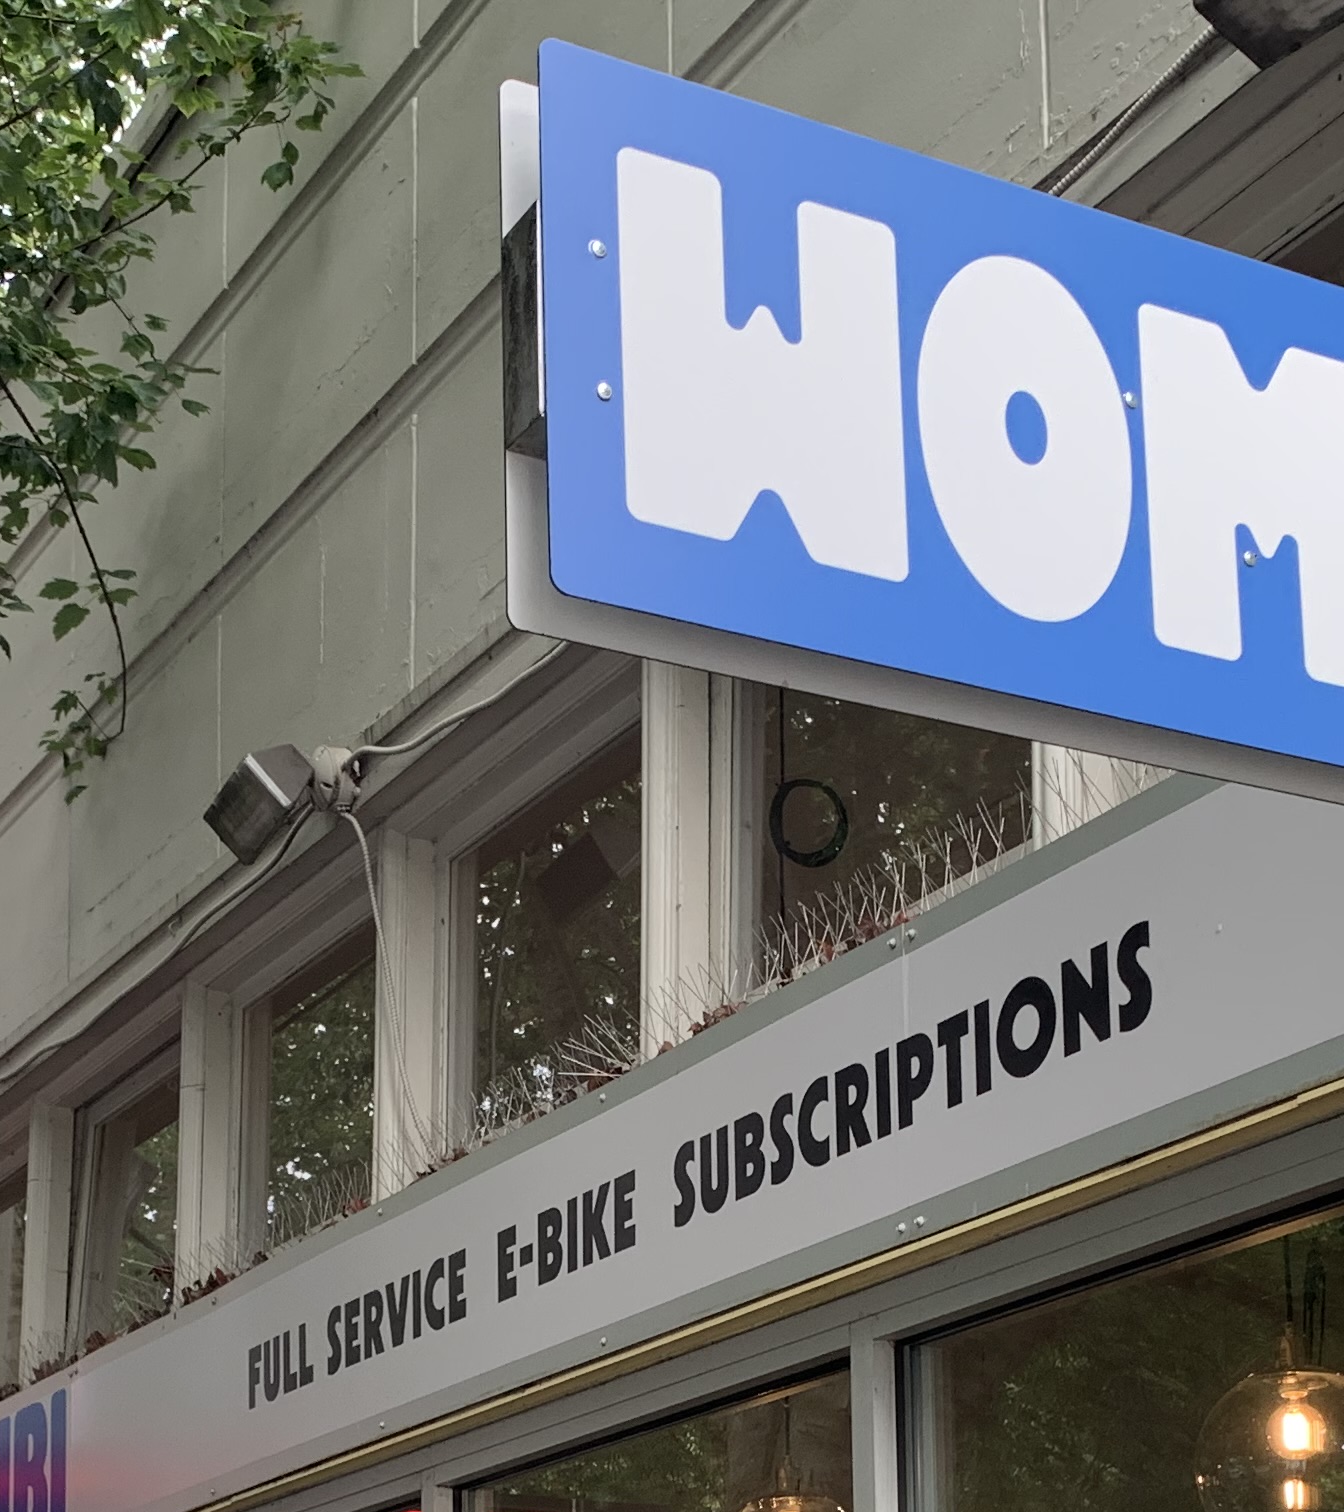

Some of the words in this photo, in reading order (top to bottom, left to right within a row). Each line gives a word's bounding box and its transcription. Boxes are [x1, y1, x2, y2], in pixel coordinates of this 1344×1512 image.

[248, 1323, 314, 1409] FULL
[327, 1248, 467, 1376] SERVICE
[497, 1169, 636, 1303] E-BIKE
[674, 920, 1153, 1227] SUBSCRIPTIONS
